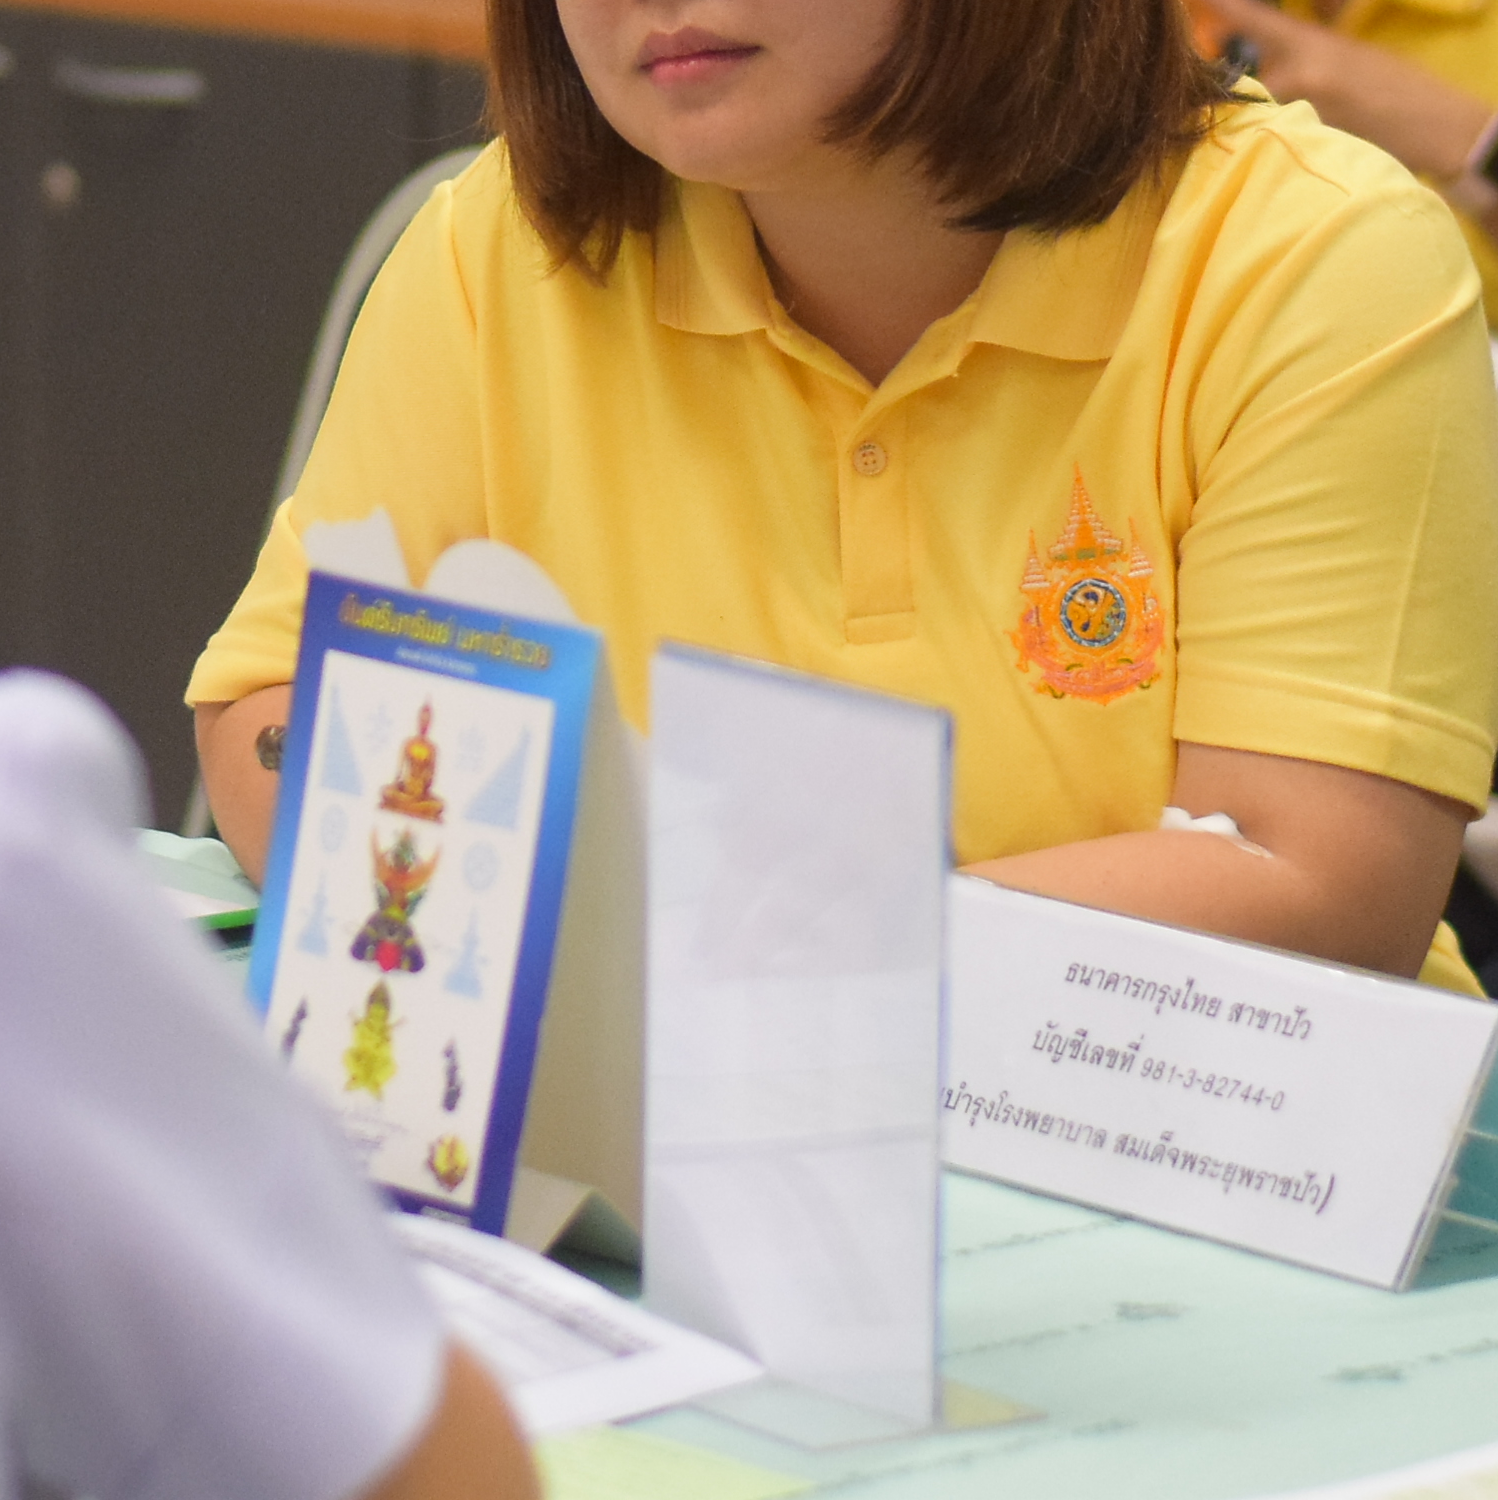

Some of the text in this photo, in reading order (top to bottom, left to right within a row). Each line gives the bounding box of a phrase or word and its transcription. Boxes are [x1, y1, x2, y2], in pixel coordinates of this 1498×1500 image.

[1064, 962, 1313, 1040] ธนาคารกรุงไทย สาขาปัว
[1031, 1019, 1286, 1111] บัญชีเลขที่ 981-3-82744-0
[940, 1080, 1108, 1148] บำรุงโรงพยาบาล
